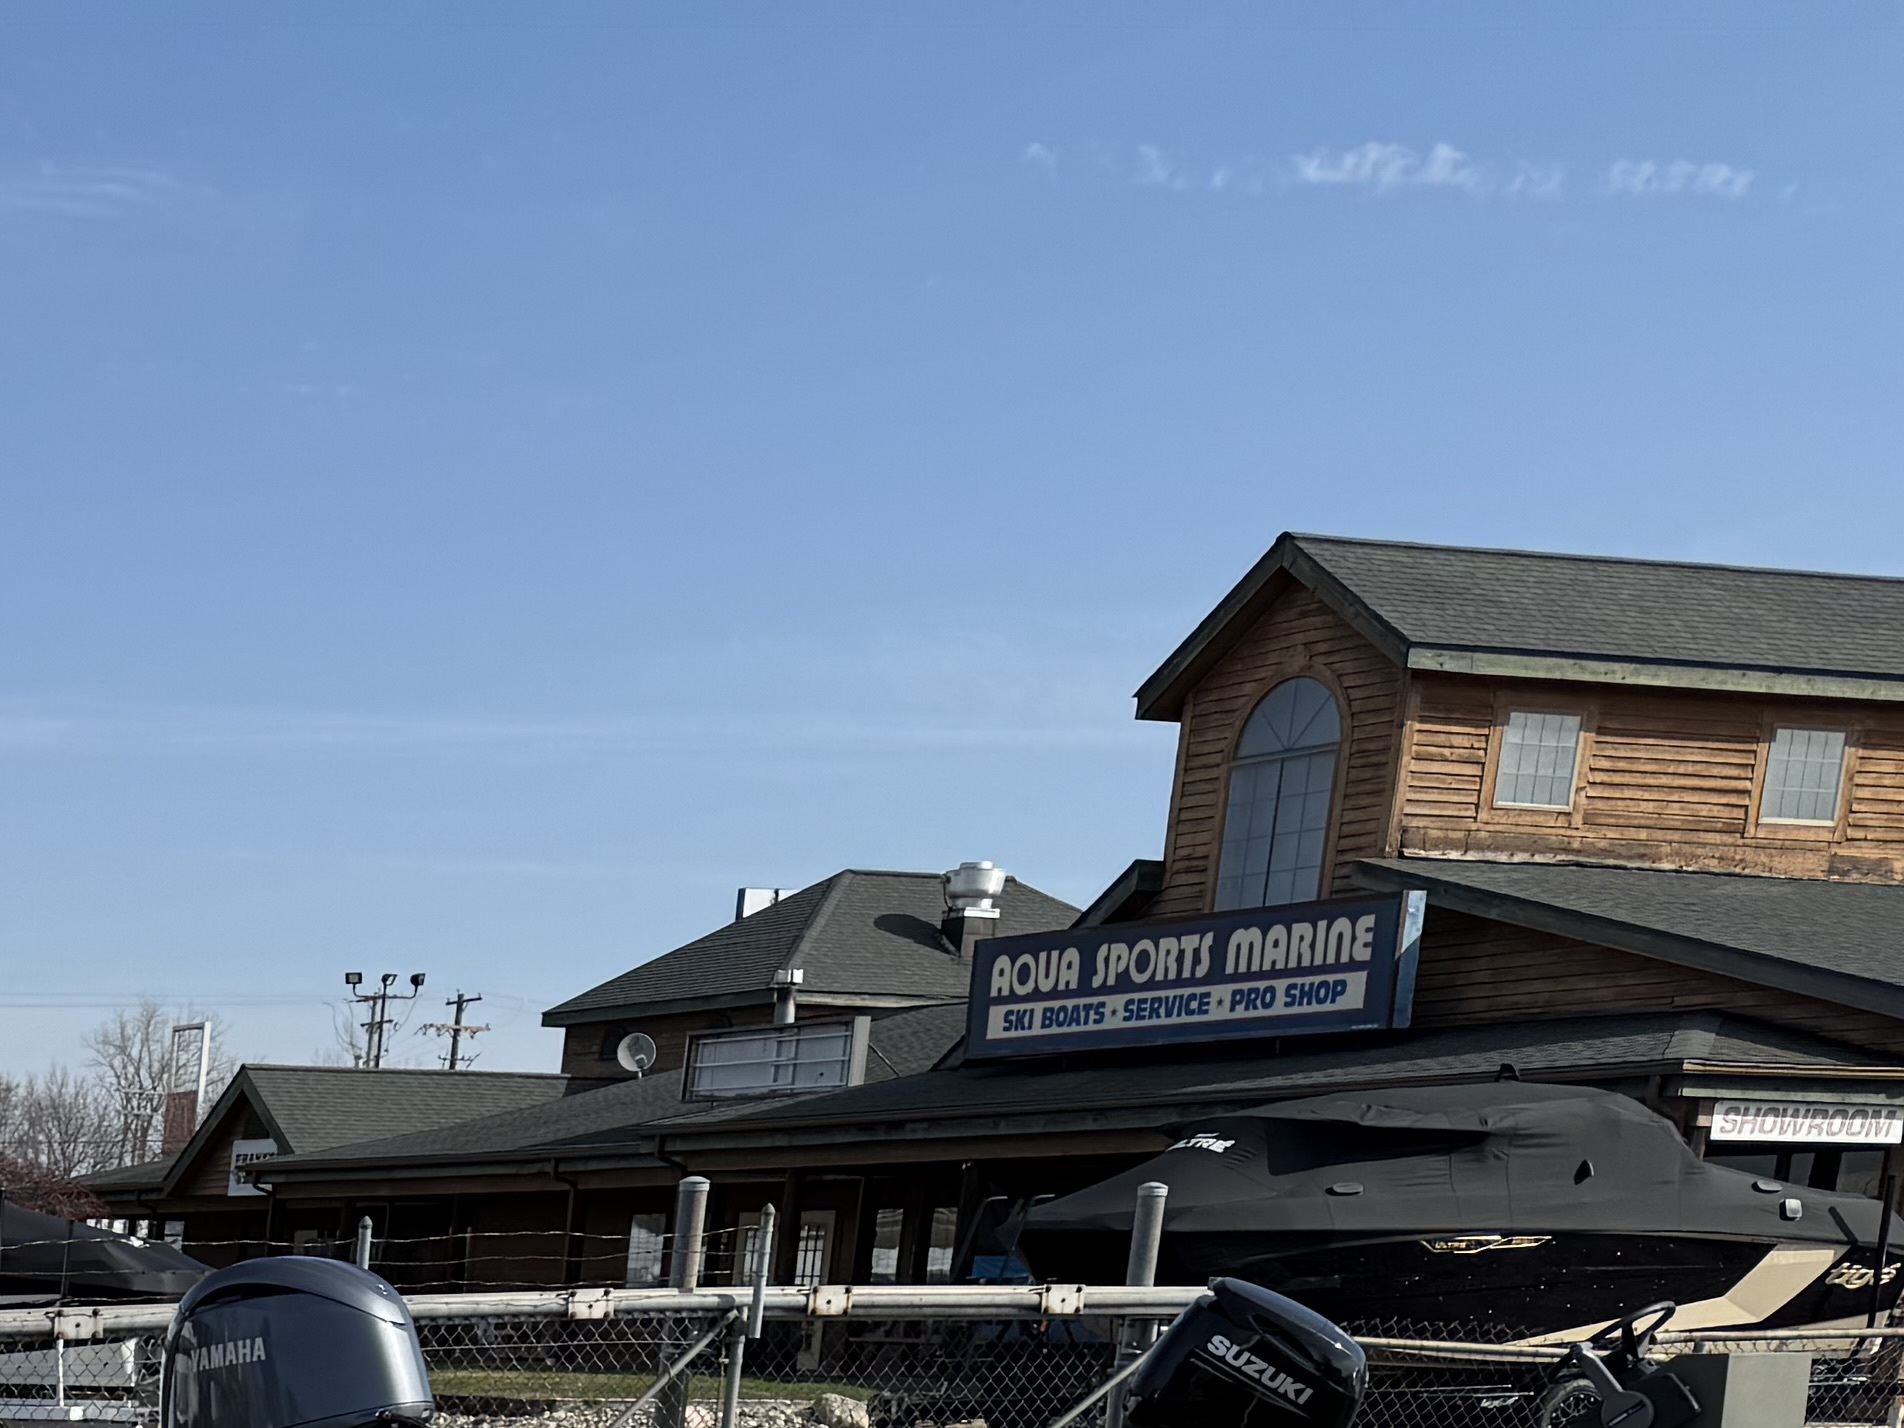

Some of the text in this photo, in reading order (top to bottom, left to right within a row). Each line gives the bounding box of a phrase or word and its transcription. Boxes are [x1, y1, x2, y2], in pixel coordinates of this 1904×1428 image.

[989, 913, 1376, 998] AQUA SPORTS MARINE
[1002, 978, 1348, 1033] SKI BOATS SERVICE PRO SHOP
[1719, 1106, 1898, 1138] SHOWROOM
[190, 1336, 267, 1373] YAMAHA
[1207, 1334, 1314, 1405] SUZUKI
